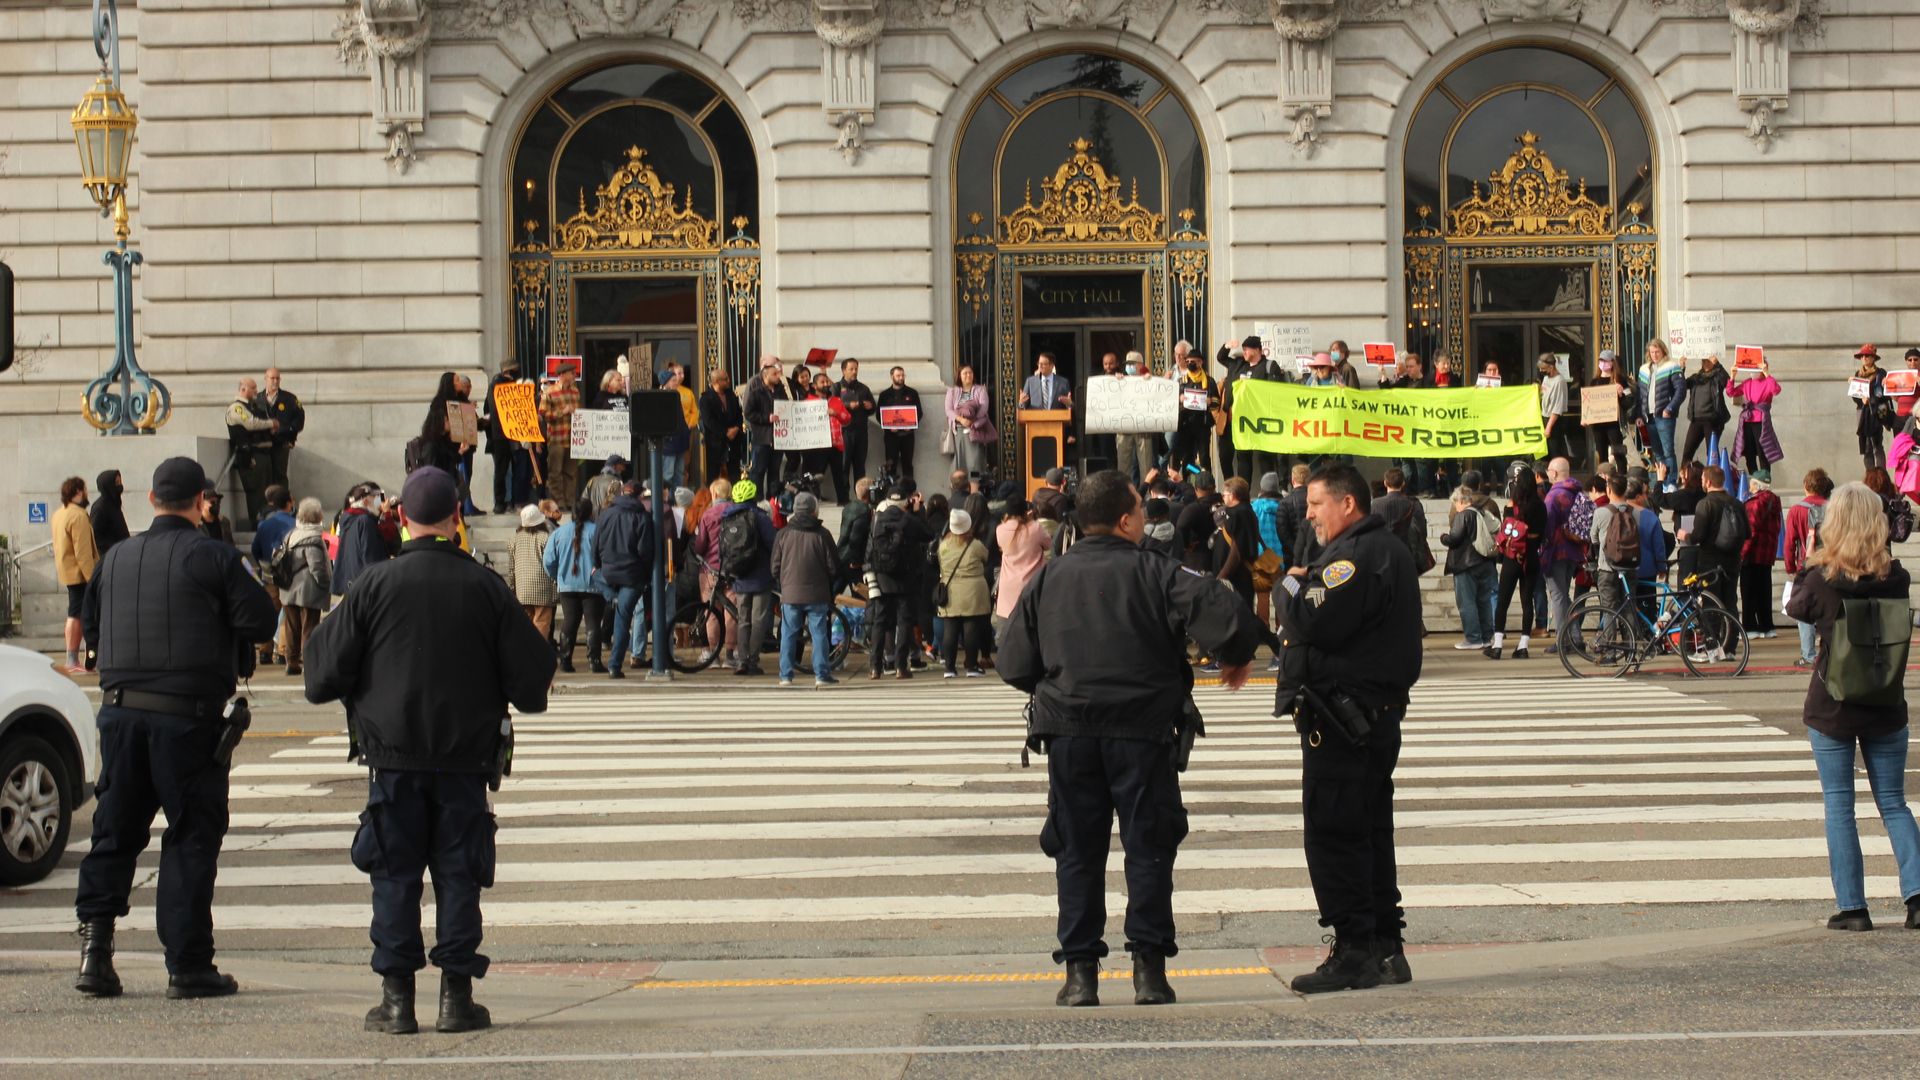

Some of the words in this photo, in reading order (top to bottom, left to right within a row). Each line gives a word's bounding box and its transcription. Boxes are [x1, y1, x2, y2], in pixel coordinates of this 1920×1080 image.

[1040, 288, 1077, 304] CITY
[1083, 288, 1126, 304] HALL
[1671, 337, 1683, 345] NO
[631, 346, 649, 361] KILL
[633, 361, 647, 371] THE
[497, 384, 531, 399] ARMED
[1091, 379, 1127, 393] STOP
[500, 397, 534, 410] ROBOTS
[1147, 399, 1176, 414] NEW
[1296, 397, 1318, 409] WE
[1323, 396, 1348, 409] ALL
[1351, 400, 1379, 415] SAW
[1382, 403, 1418, 416] THAT
[1422, 407, 1480, 420] MOVIE...
[509, 427, 541, 439] ANSWER
[572, 430, 589, 438] VOTE
[775, 428, 788, 438] NO
[1239, 415, 1284, 435] NO
[1292, 418, 1406, 444] KILLER
[1411, 426, 1543, 449] ROBOTS
[572, 438, 586, 446] NO
